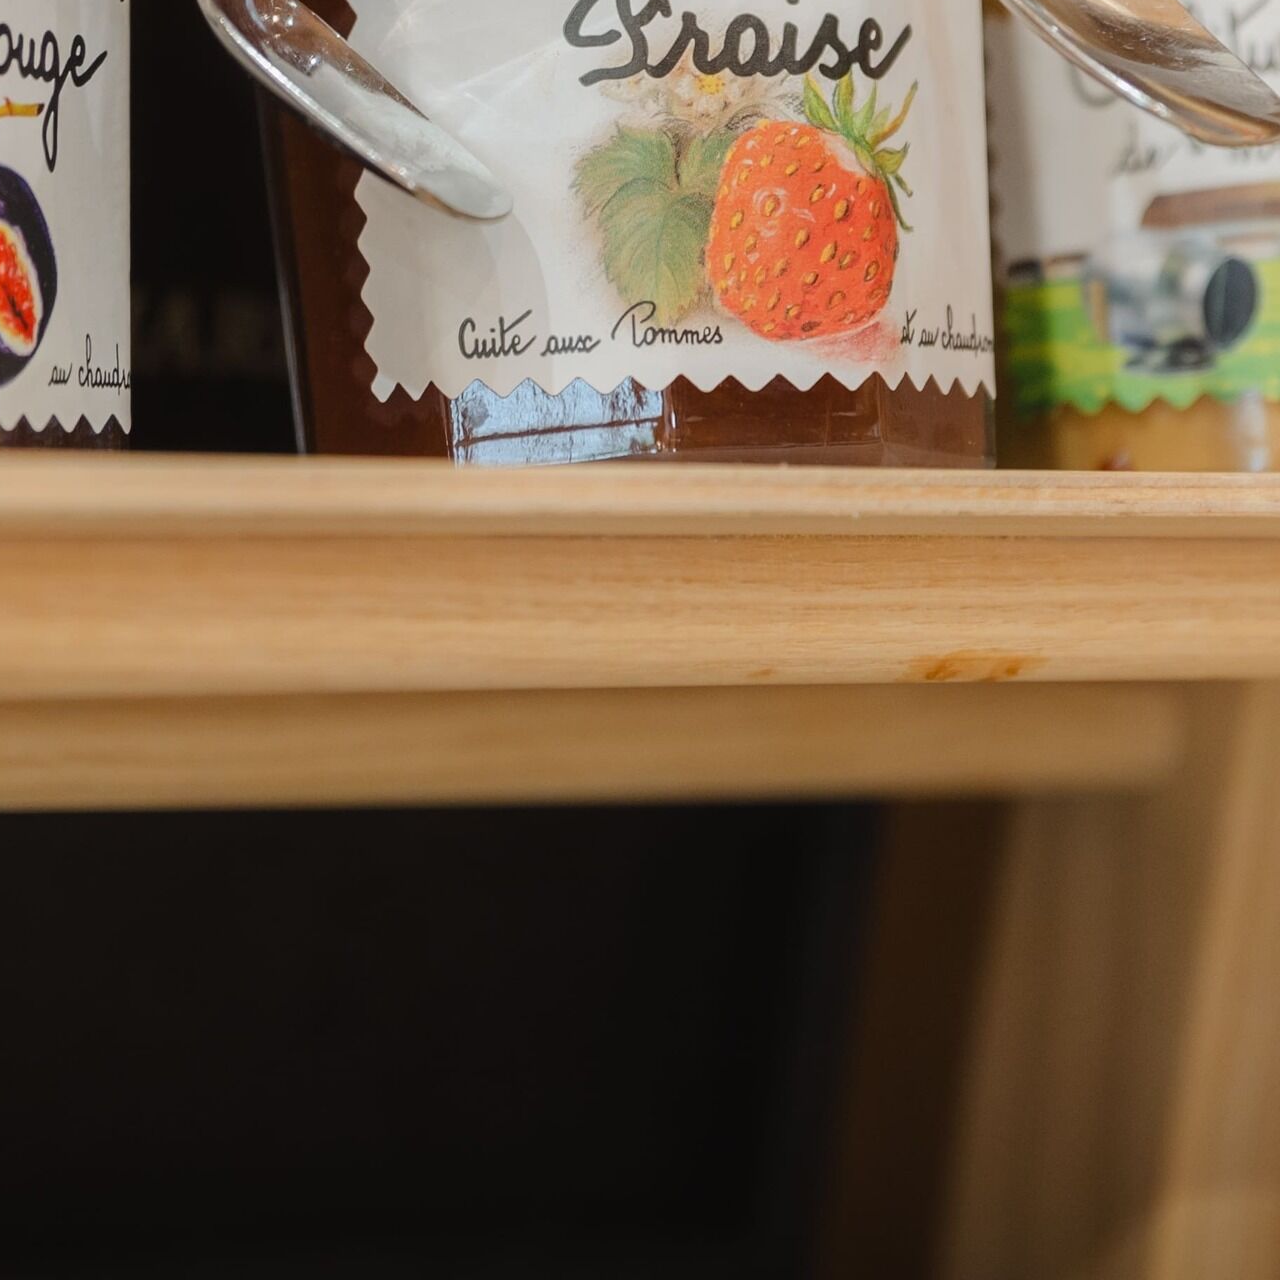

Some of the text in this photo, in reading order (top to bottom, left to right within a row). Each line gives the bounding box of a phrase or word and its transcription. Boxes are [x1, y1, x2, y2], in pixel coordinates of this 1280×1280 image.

[458, 301, 724, 360] Cuite aux Pommes
[918, 326, 940, 348] au
[48, 362, 73, 387] au
